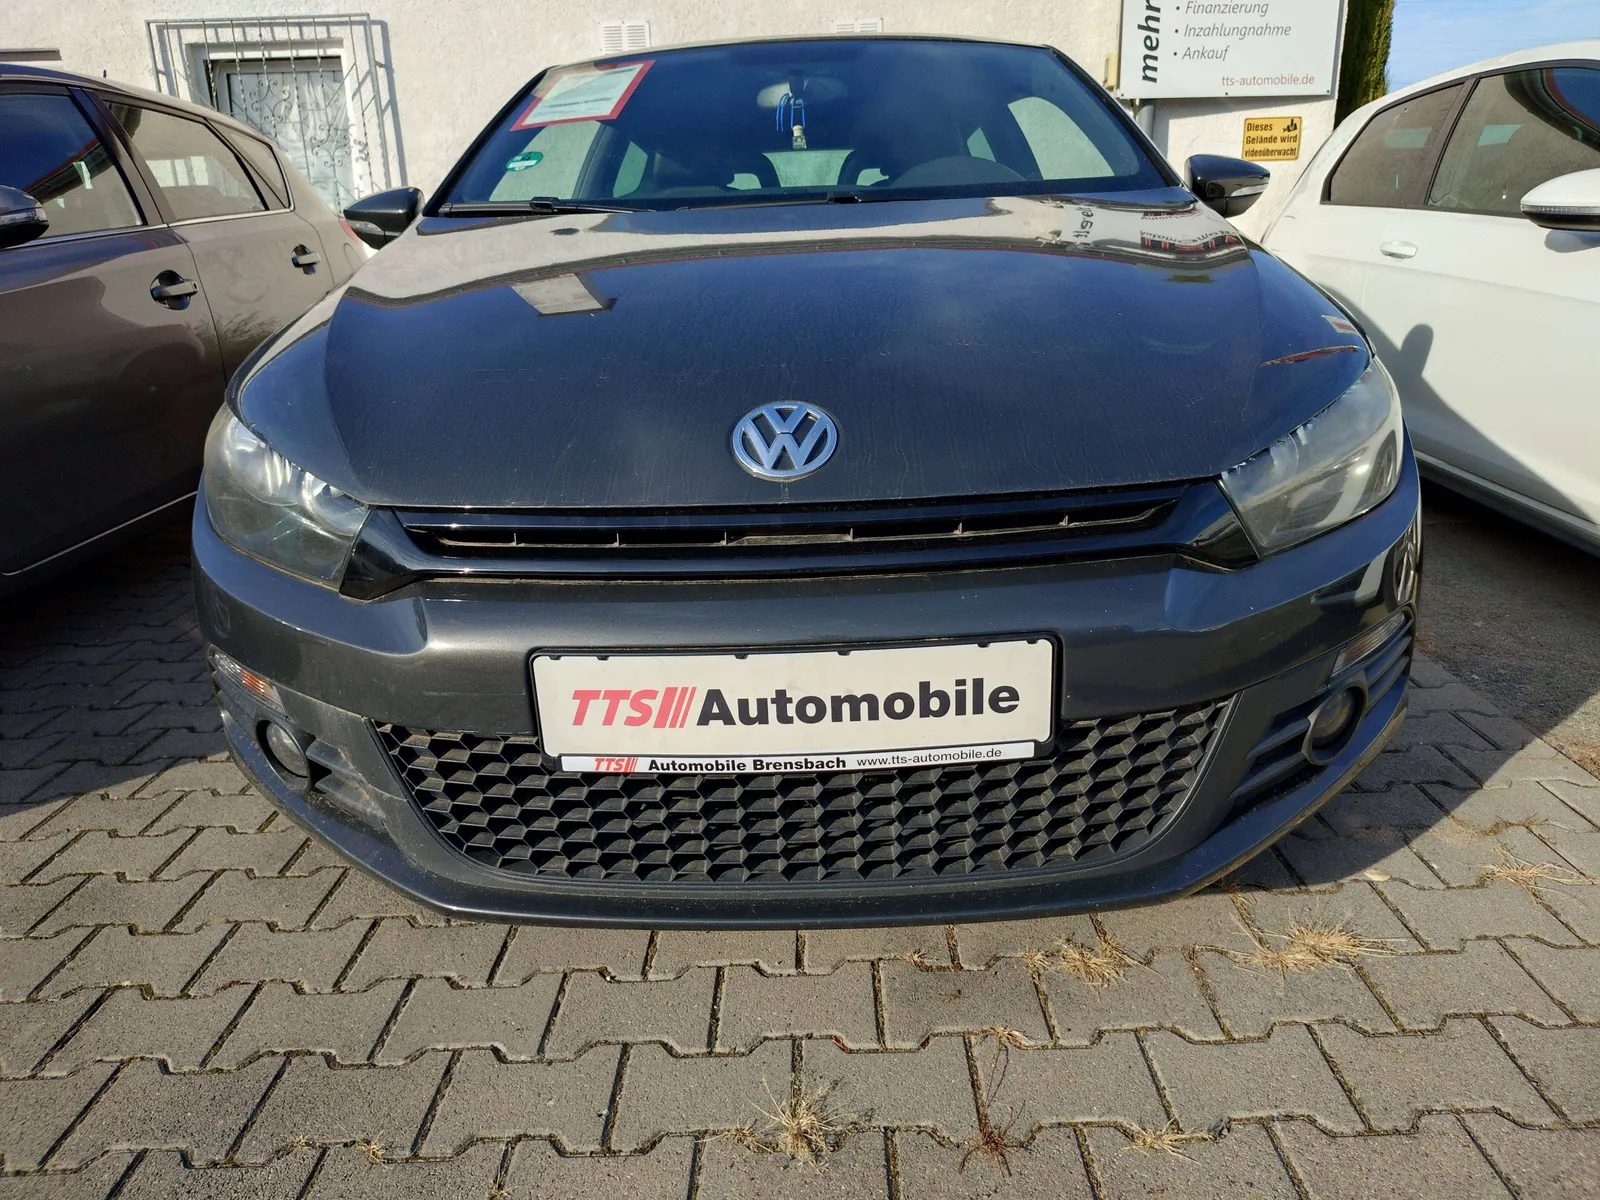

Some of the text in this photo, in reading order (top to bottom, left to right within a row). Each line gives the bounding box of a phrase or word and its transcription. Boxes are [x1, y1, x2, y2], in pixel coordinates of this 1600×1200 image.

[1185, 1, 1269, 17] Finanzierung
[1183, 24, 1292, 40] Inzahlungnahme
[1137, 0, 1161, 83] mehr
[1182, 45, 1230, 61] Ankauf
[1221, 74, 1315, 87] tts-automobile.de
[1246, 122, 1273, 132] Dieses
[1245, 133, 1298, 145] Gelände wird
[1244, 147, 1297, 157] videoüberwacht
[733, 401, 838, 478] VW
[571, 677, 1020, 727] TTS Automobile
[594, 747, 1002, 772] TTS Automobile Brensbach www.tts-automobile.de
